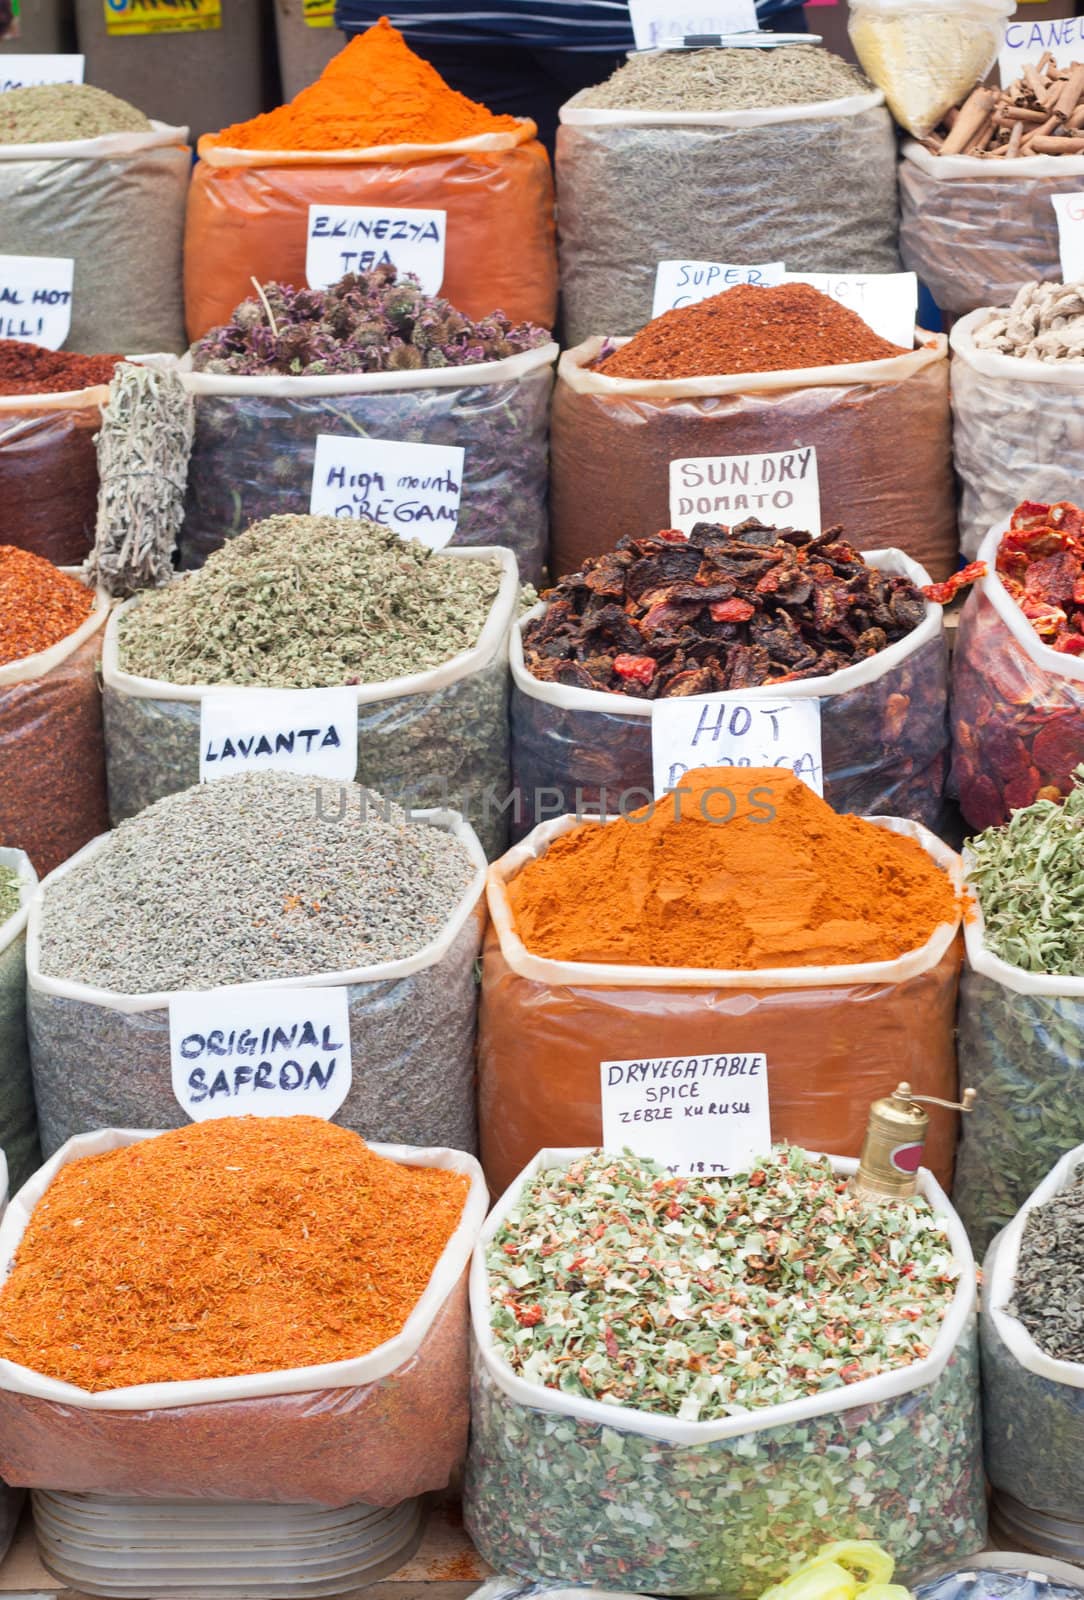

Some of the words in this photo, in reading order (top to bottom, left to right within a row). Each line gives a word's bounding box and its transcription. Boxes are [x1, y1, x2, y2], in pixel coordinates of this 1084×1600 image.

[312, 216, 440, 243] EKINEZYA
[340, 250, 392, 272] TEA
[677, 264, 763, 288] SUPER
[32, 289, 71, 306] HOT
[326, 466, 385, 503] High
[678, 490, 794, 516] DOMATO
[690, 703, 793, 747] HOT
[205, 725, 342, 762] LAVANTA
[180, 1020, 344, 1060] ORIGINAL
[187, 1057, 337, 1103] SAFRON
[646, 1081, 701, 1103] SPICE
[619, 1106, 674, 1124] ZEBZE
[690, 1161, 705, 1173] 18
